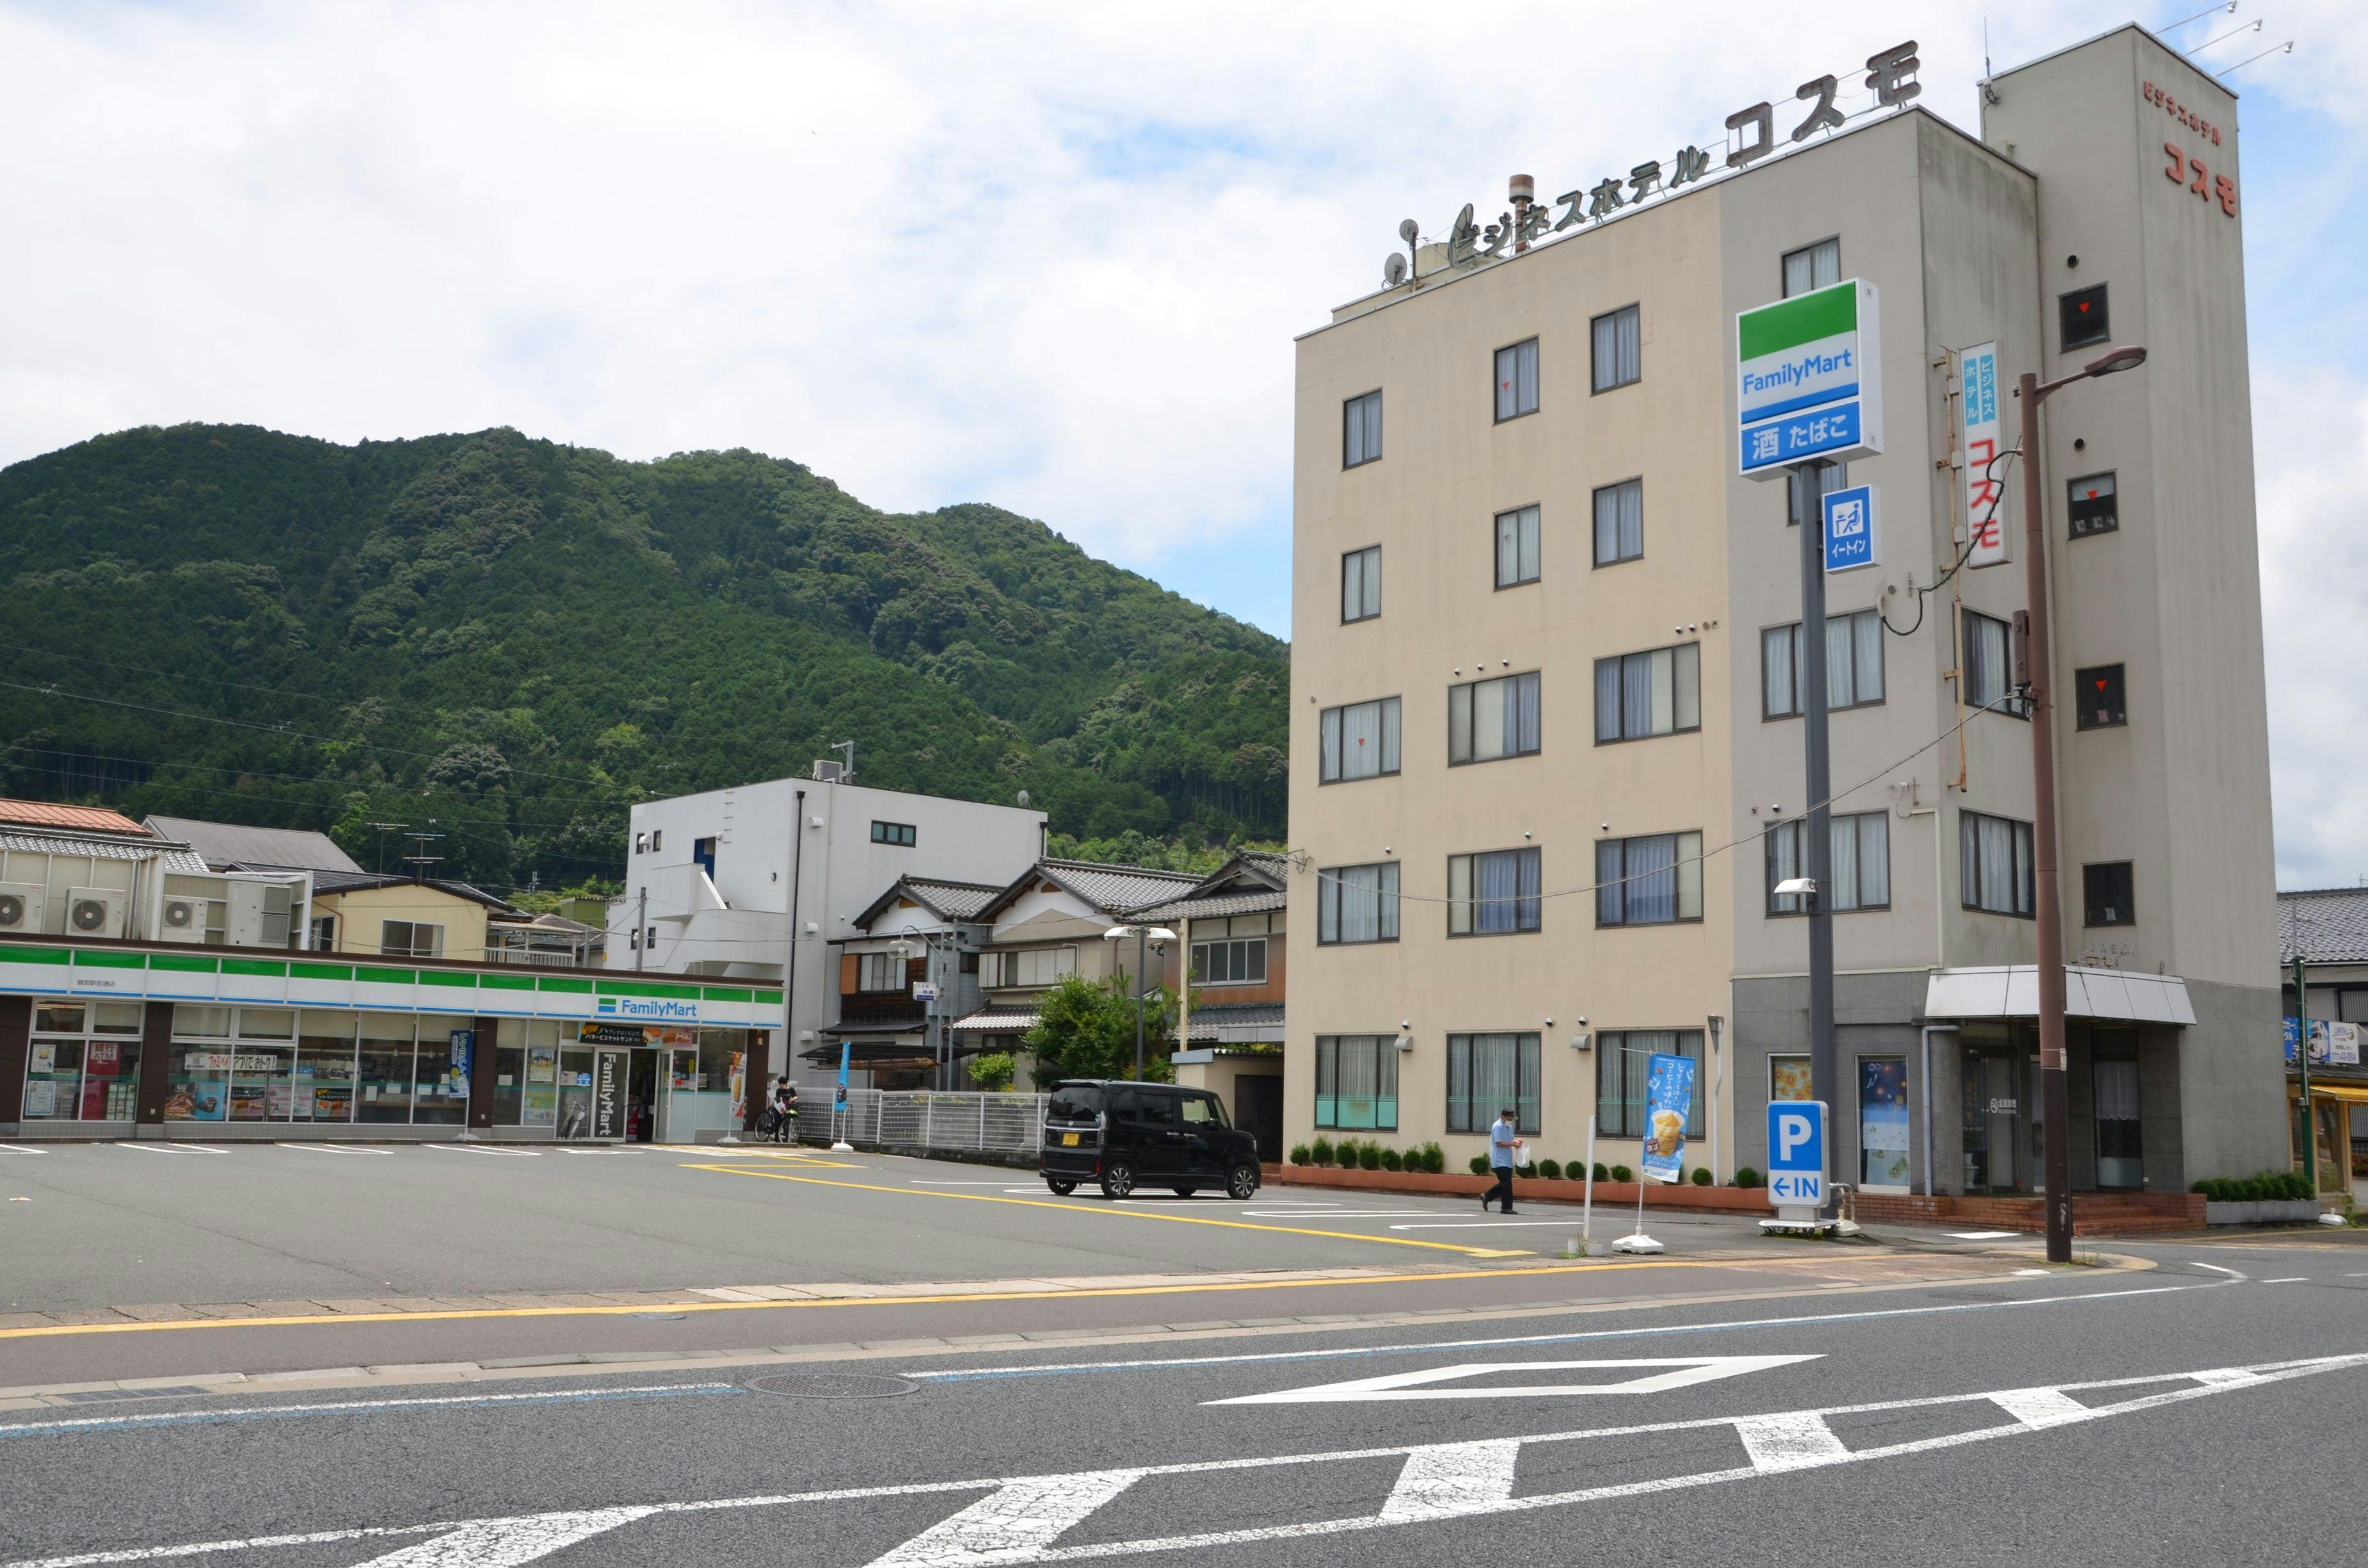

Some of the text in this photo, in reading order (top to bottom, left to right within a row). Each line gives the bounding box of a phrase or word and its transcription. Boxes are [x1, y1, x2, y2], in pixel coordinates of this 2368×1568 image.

[2143, 81, 2222, 146] ビジネスホテル
[1448, 40, 1922, 270] ビジネスホテル コスモ
[2164, 142, 2238, 218] コスモ
[1743, 348, 1852, 395] FamilyMart
[1964, 365, 1979, 421] ホテル
[1981, 360, 1995, 415] ビジネス
[1752, 414, 1848, 461] 酒 たばこ
[1968, 437, 2000, 550] コスモ
[1831, 539, 1866, 559] イートイン
[621, 1000, 697, 1017] FamilyMart
[94, 1043, 114, 1052] 銀行
[585, 1034, 633, 1043] バタービスケットサンド
[599, 1053, 618, 1136] FamilyMart
[1663, 1062, 1675, 1109] コーヒーの味わい
[1673, 1062, 1685, 1106] シャリッと冷たい
[1779, 1115, 1813, 1161] P
[1794, 1177, 1818, 1198] IN
